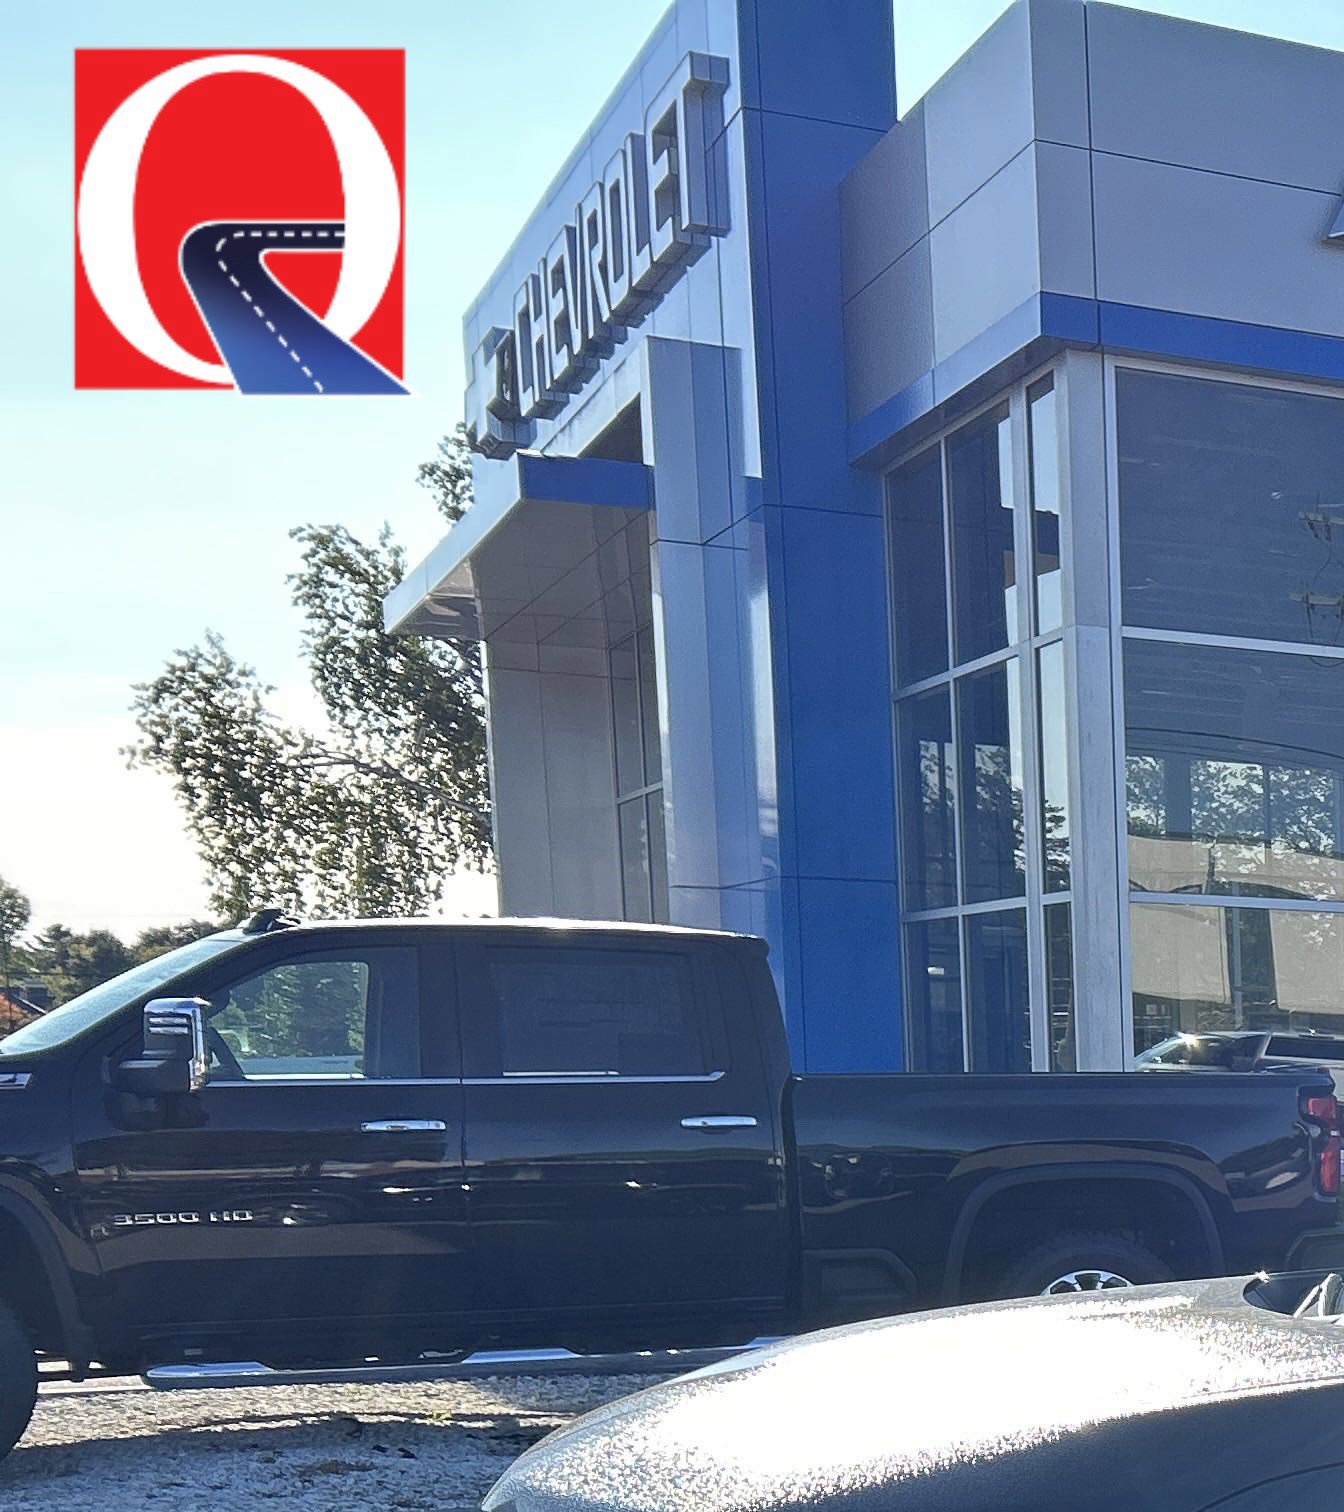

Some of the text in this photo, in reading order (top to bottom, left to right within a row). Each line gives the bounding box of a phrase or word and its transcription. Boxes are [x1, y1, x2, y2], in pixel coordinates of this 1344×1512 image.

[512, 50, 732, 420] CHEVROLET
[112, 1209, 254, 1226] 3500 HD
